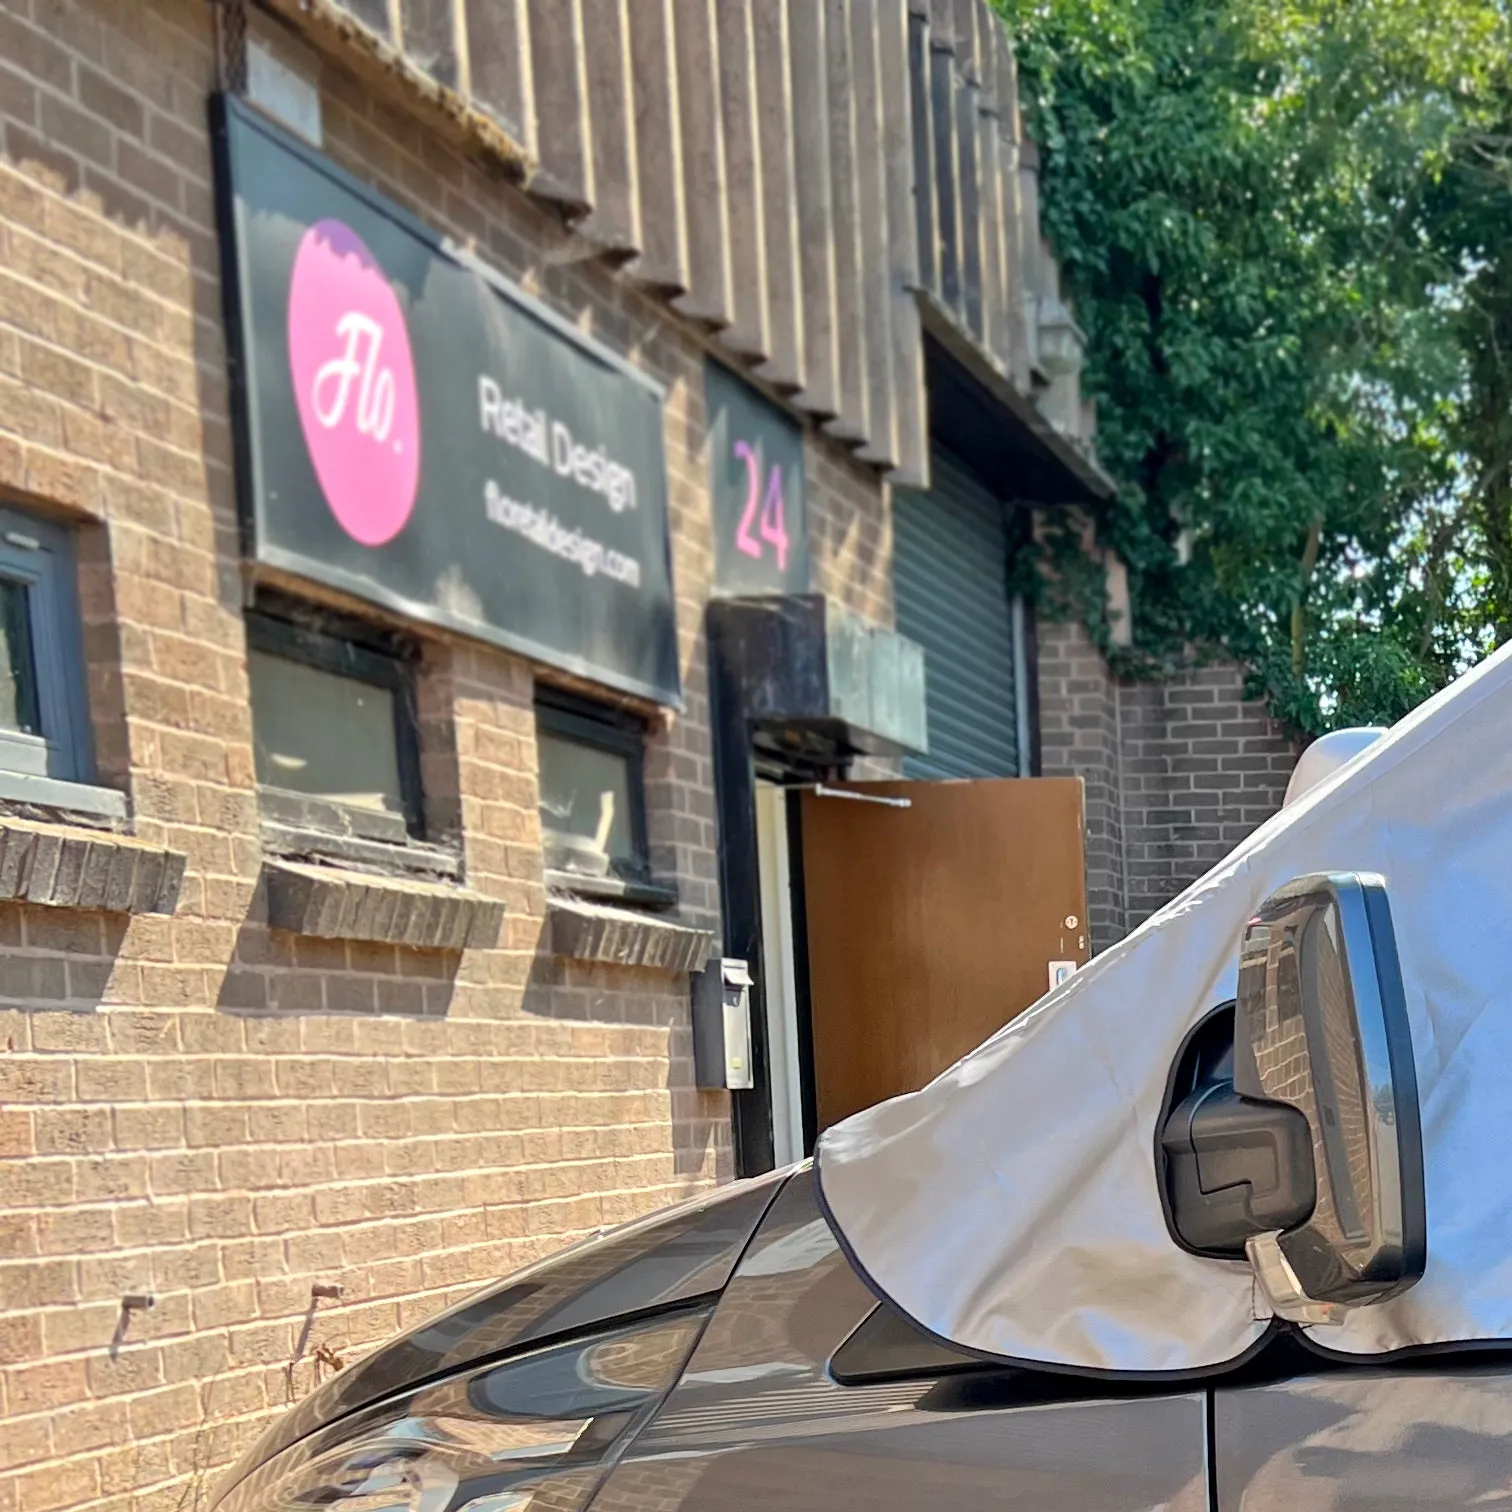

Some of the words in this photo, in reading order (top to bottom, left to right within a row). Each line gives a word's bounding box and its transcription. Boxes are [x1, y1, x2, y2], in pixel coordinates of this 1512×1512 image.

[480, 373, 548, 466] Retail
[553, 420, 637, 514] Design
[734, 440, 788, 573] 24
